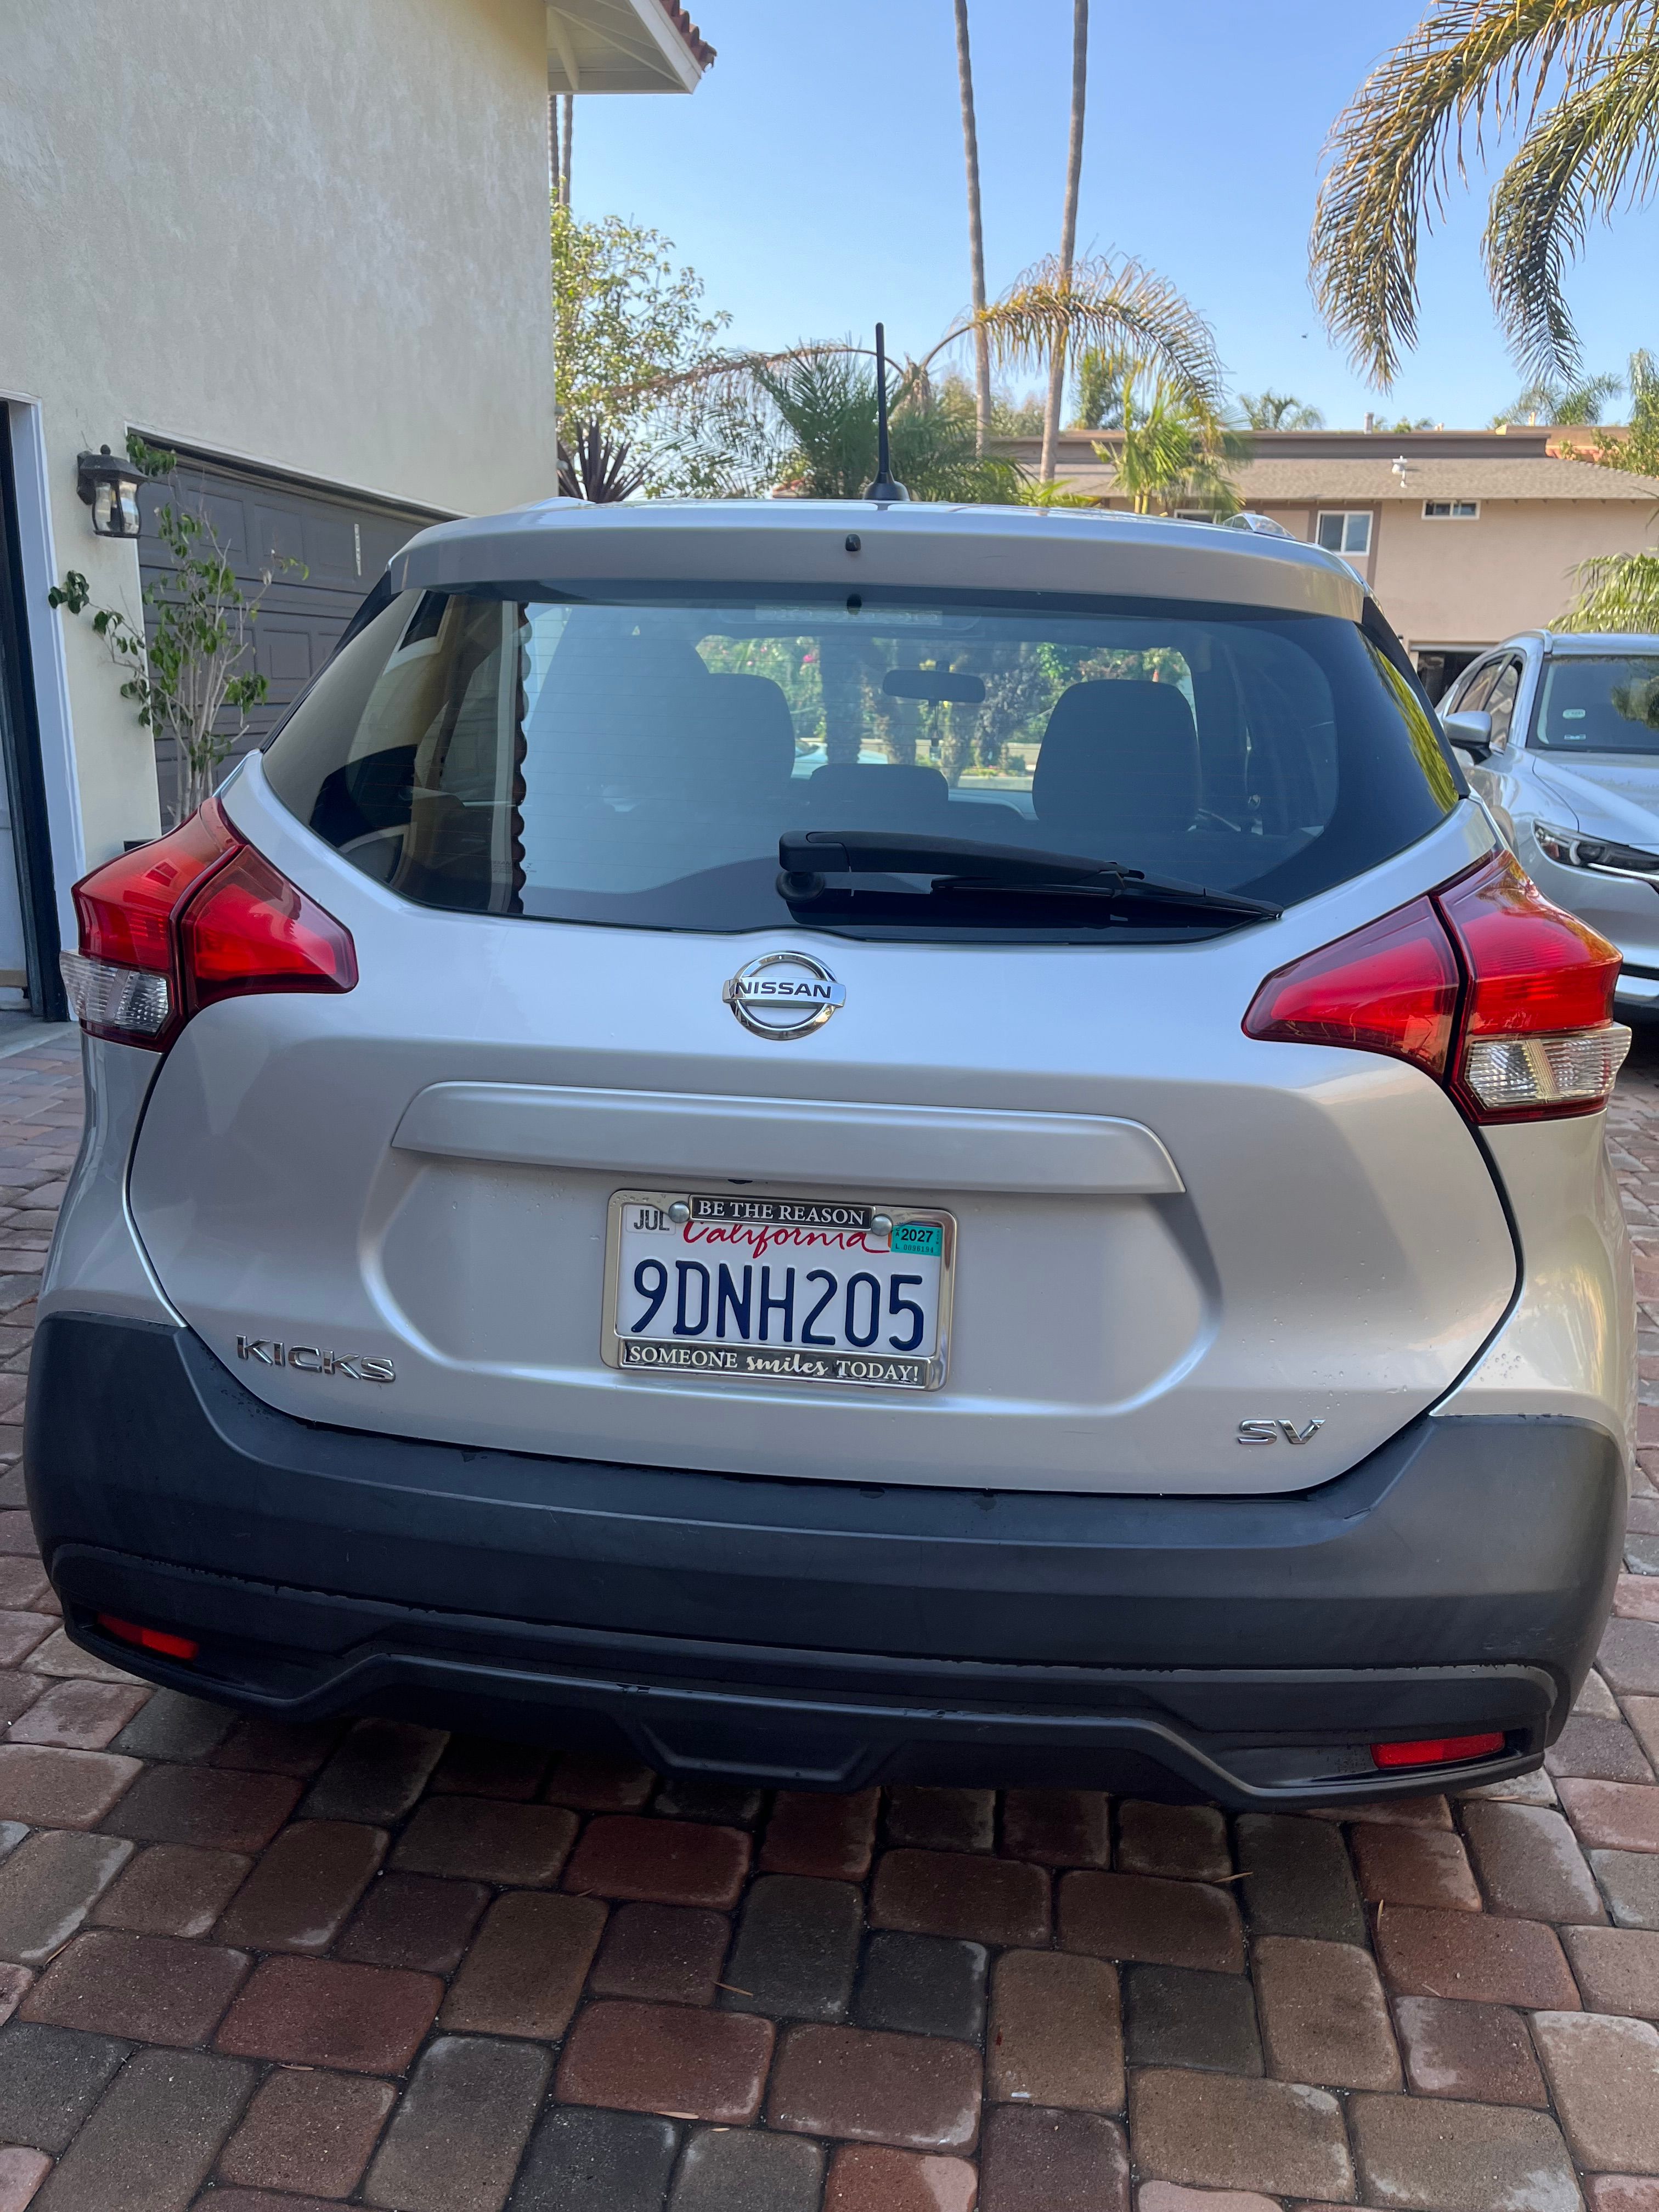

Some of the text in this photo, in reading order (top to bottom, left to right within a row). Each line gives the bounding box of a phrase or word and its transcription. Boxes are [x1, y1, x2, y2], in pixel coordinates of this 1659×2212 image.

[736, 981, 832, 998] NISSAN
[633, 1209, 670, 1231] JUL
[698, 1200, 865, 1226] BE THE REASON
[683, 1221, 890, 1259] California
[901, 1228, 934, 1243] 2027
[631, 1259, 924, 1351] 9DNH205
[236, 1334, 396, 1383] KICKS
[630, 1346, 919, 1382] SOMEONE smiles TODAY!
[1238, 1419, 1326, 1444] SV
